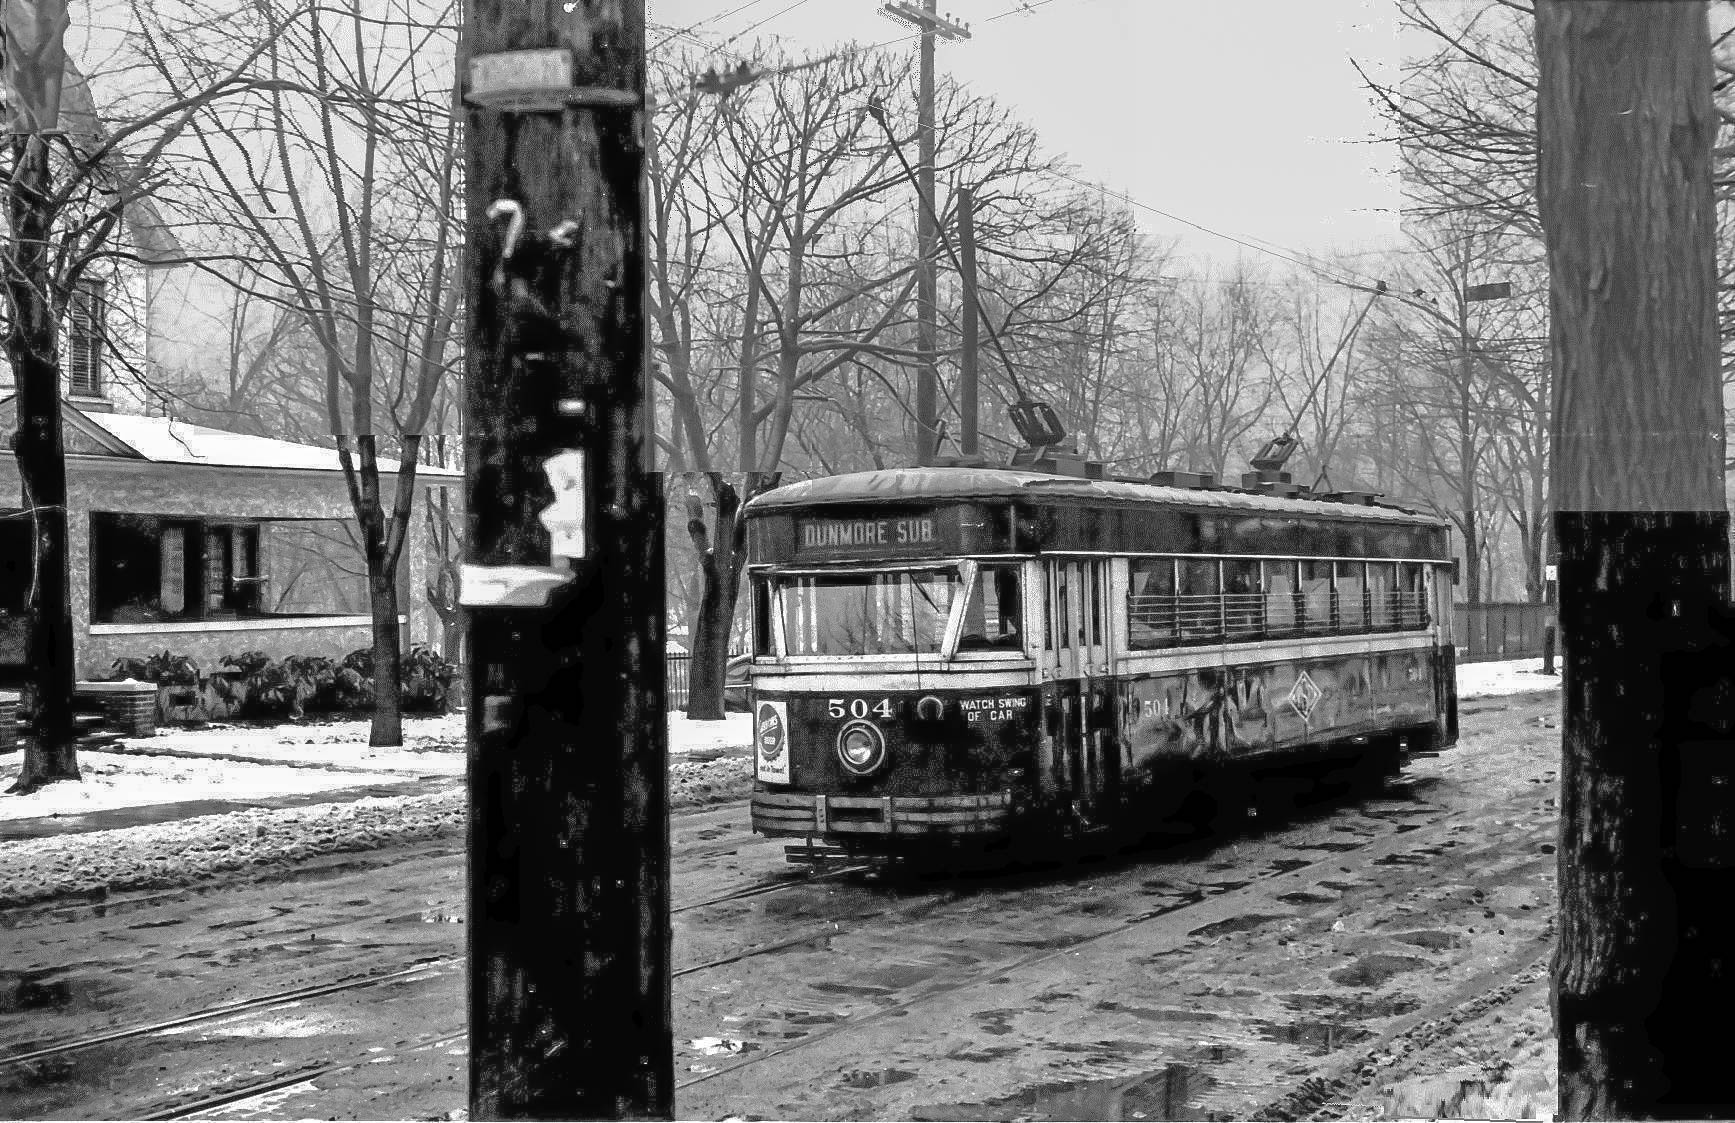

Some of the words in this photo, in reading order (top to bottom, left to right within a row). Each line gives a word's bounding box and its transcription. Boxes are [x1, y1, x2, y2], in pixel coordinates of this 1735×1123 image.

[804, 520, 888, 546] DUNMORE
[828, 697, 893, 719] 504
[959, 698, 995, 710] WATCH
[998, 697, 1027, 709] SWING
[967, 711, 981, 722] OF
[990, 709, 1013, 721] CAR
